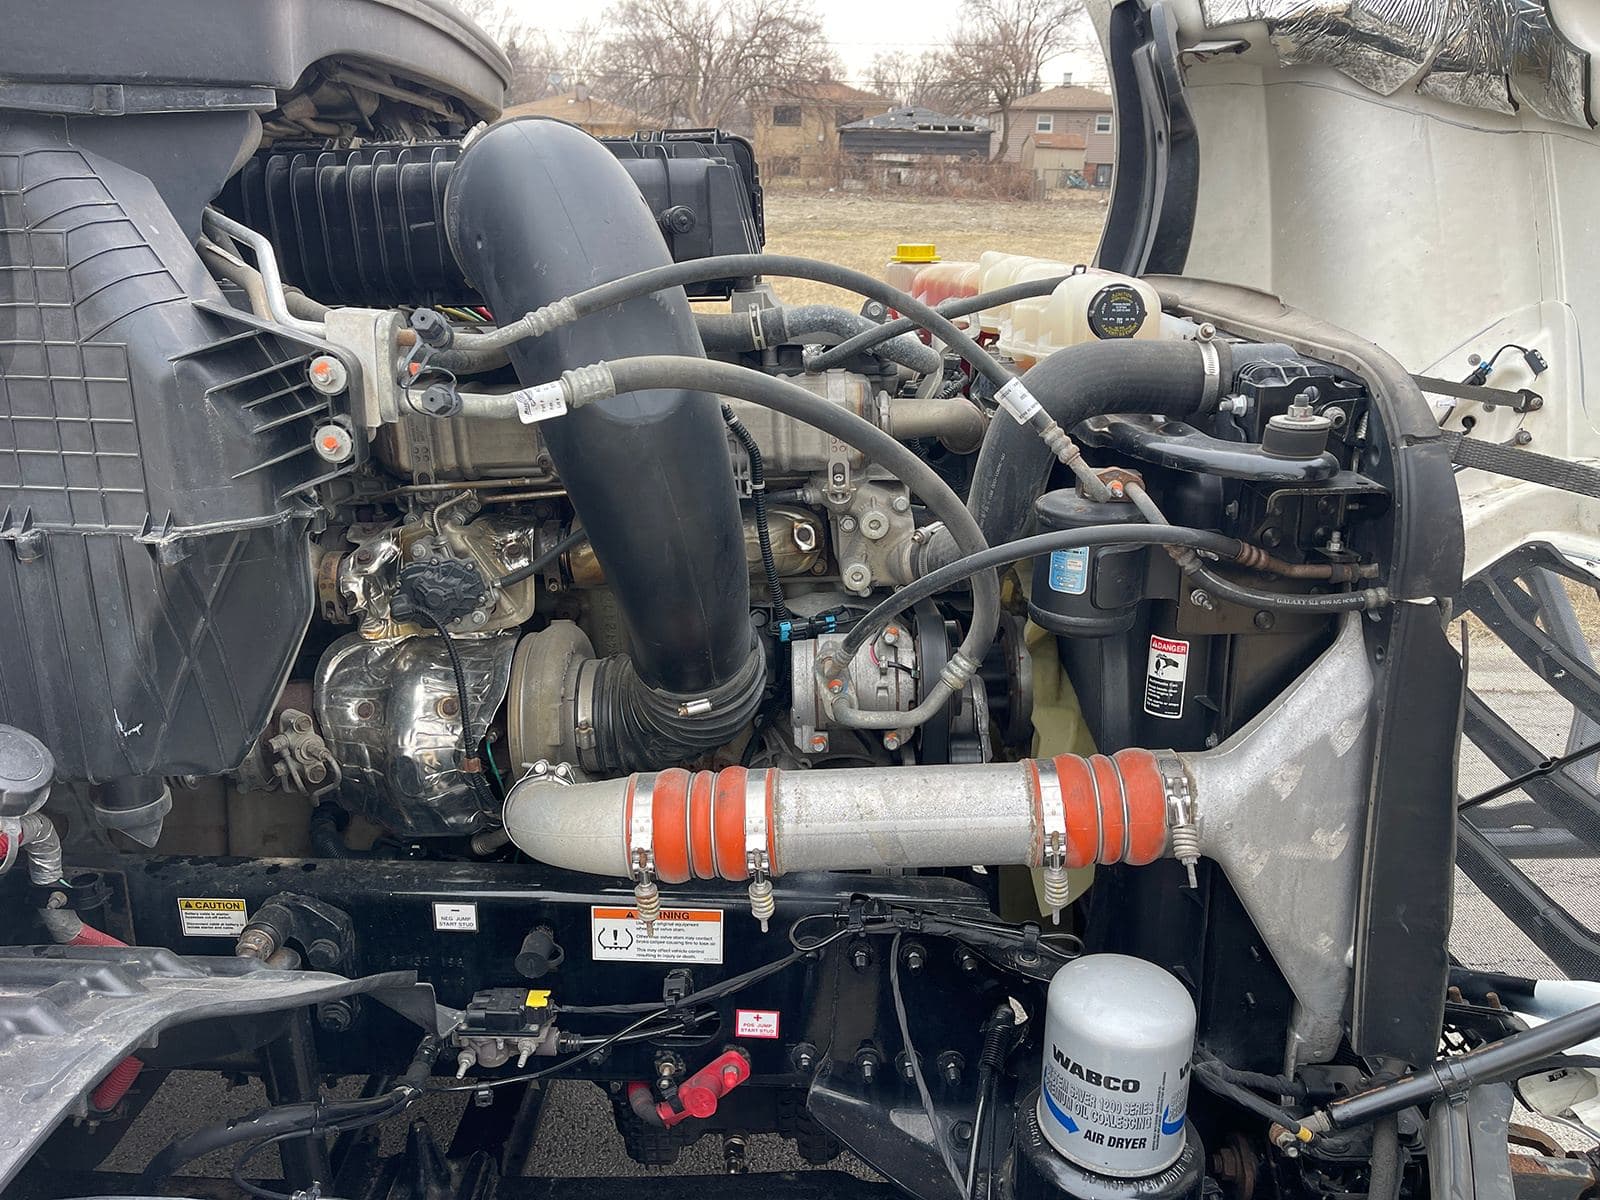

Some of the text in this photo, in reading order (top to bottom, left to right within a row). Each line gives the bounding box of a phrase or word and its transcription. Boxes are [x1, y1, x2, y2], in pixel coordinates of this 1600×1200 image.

[1157, 642, 1187, 653] DANGER
[195, 902, 240, 910] CAUTION
[660, 911, 690, 920] NING
[1052, 1044, 1140, 1093] WABCO
[1075, 1101, 1089, 1121] OIL
[1091, 1110, 1152, 1130] COALESCING
[1099, 1096, 1122, 1115] 1200
[1123, 1101, 1154, 1117] SERIES
[1083, 1128, 1147, 1150] AIR DRYER
